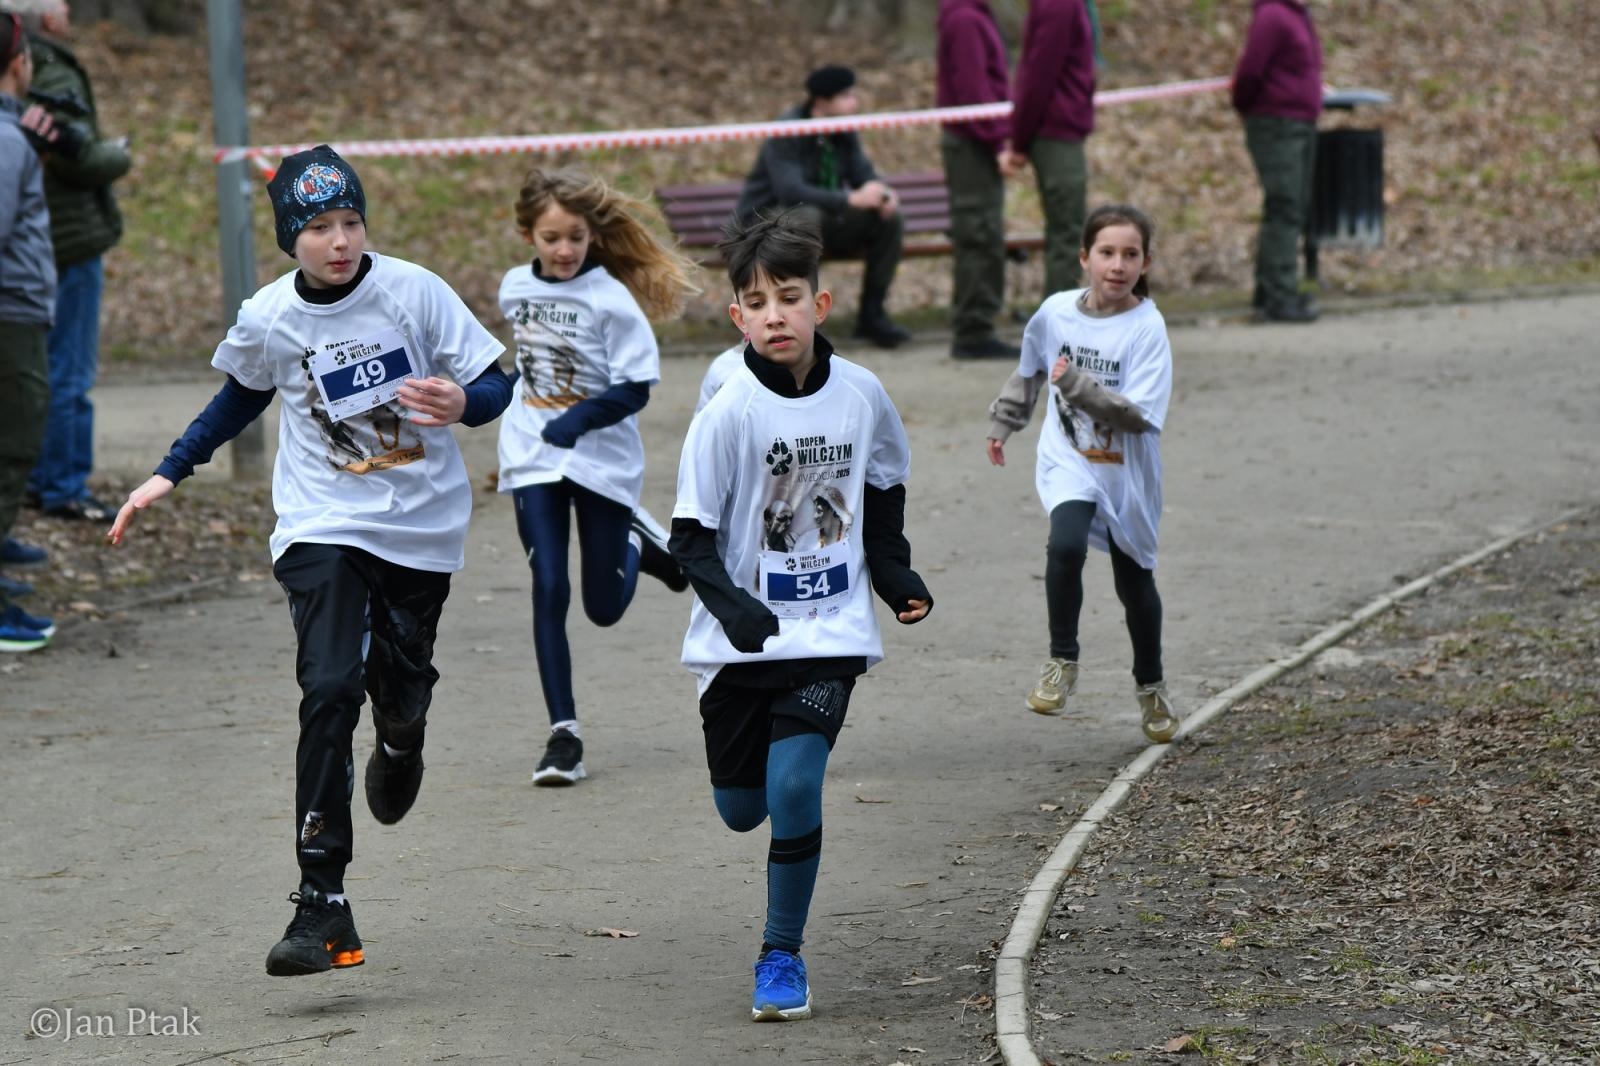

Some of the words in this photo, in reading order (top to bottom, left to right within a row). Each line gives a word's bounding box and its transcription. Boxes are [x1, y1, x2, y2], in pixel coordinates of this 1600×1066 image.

[349, 342, 382, 360] WILCZYM
[1076, 355, 1120, 373] WILCZYM
[352, 359, 386, 388] 49
[794, 436, 826, 448] TROPEM
[797, 443, 852, 465] WILCZYM
[800, 556, 831, 569] WILCZYM
[796, 572, 831, 599] 54
